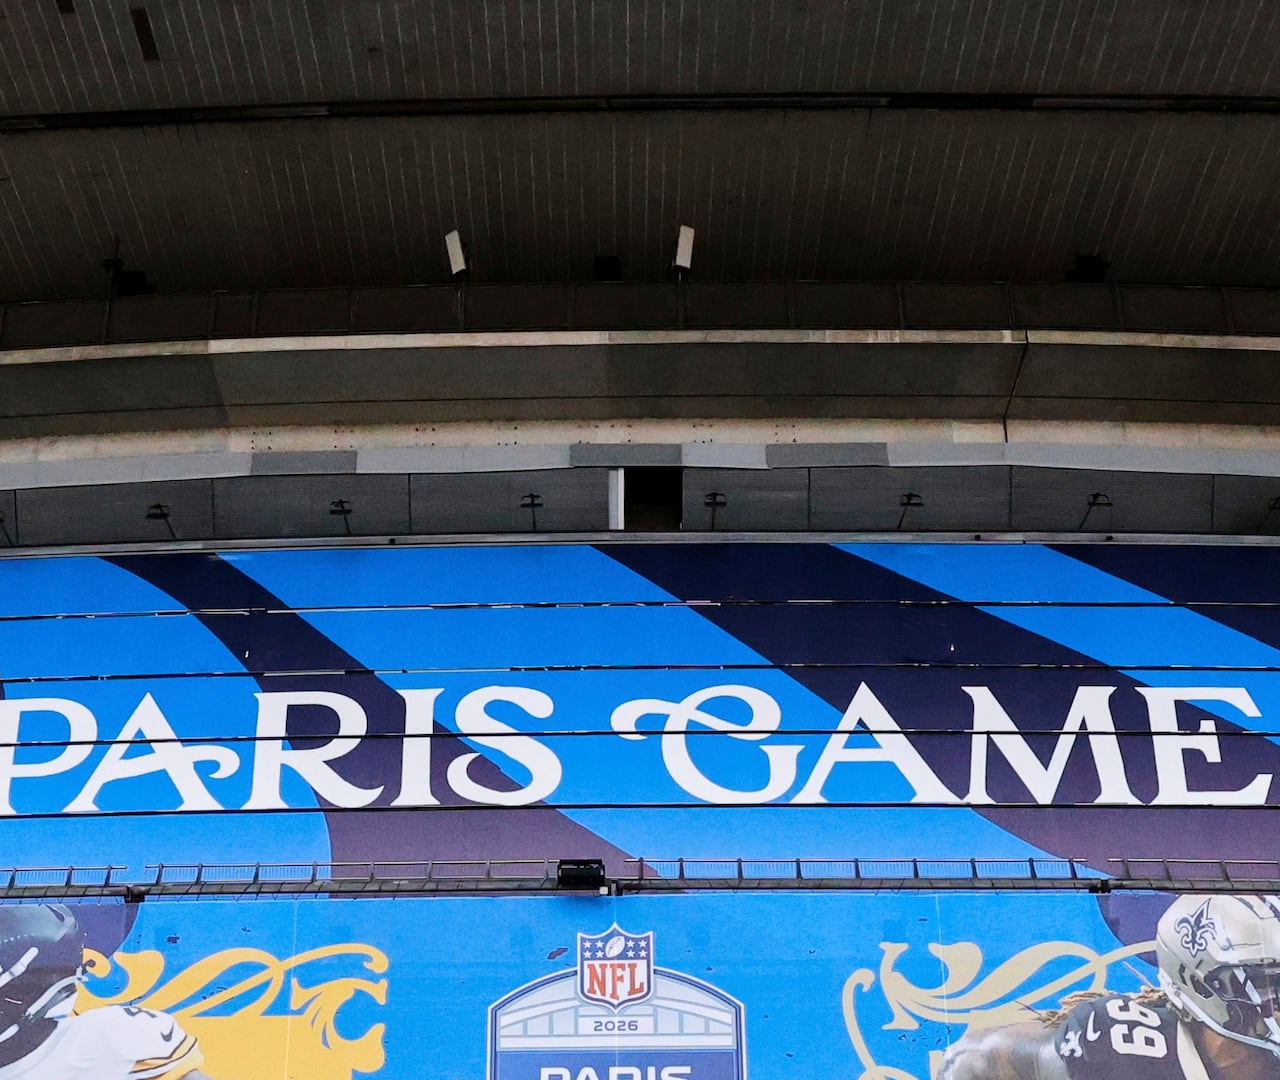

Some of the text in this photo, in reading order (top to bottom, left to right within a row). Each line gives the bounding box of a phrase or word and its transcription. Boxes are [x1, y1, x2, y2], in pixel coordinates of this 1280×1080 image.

[610, 681, 1272, 805] GAME
[587, 963, 645, 1000] NFL
[593, 1021, 638, 1032] 2026
